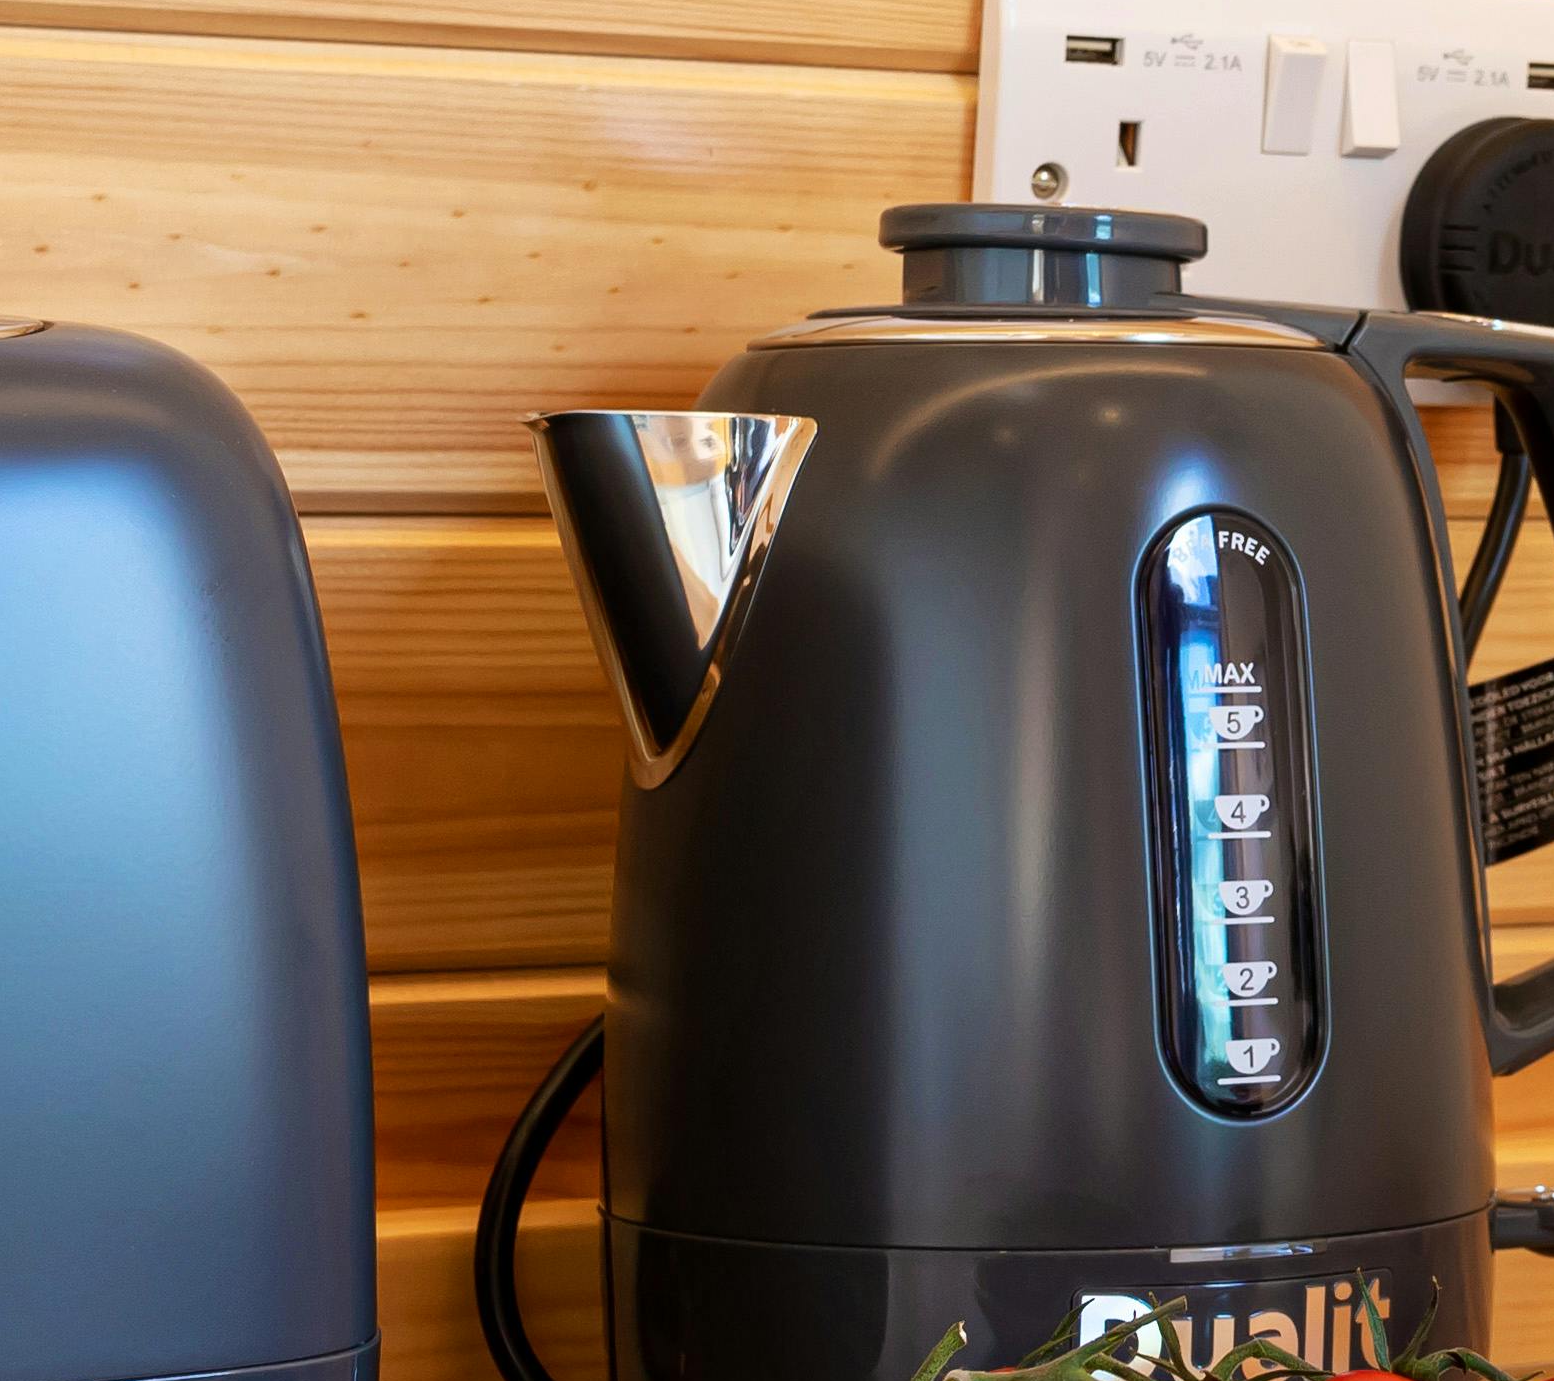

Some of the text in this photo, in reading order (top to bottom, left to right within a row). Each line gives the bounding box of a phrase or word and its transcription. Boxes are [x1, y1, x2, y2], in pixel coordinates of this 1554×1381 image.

[1143, 50, 1243, 71] 5V 2.1A
[1218, 530, 1271, 566] FREE
[1203, 661, 1256, 685] MAX
[1226, 711, 1242, 735] 5
[1230, 799, 1247, 825] 4
[1234, 885, 1251, 910] 3
[1239, 967, 1255, 992] 2
[1242, 1044, 1255, 1069] 1
